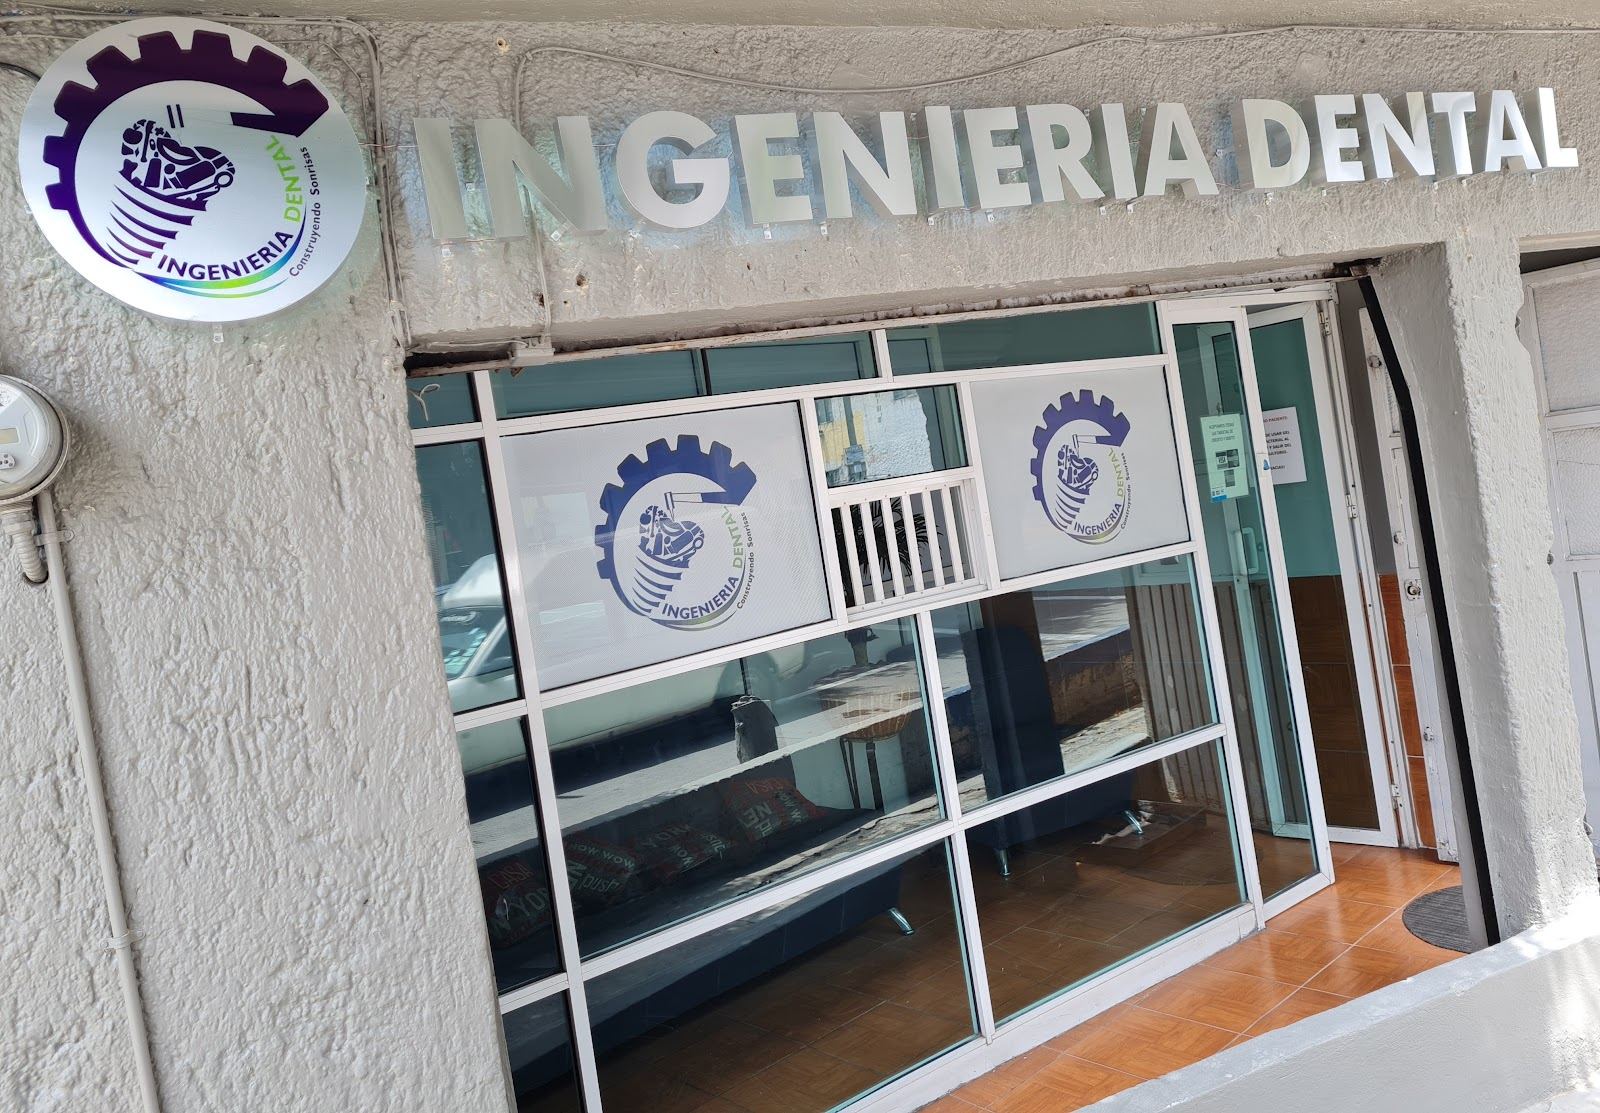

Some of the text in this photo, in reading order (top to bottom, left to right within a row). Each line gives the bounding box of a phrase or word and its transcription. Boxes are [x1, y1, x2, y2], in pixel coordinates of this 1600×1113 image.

[157, 136, 302, 280] INGENIERIA DENTAL
[289, 146, 322, 277] Construyendo Sonrisas
[413, 87, 1579, 240] INGENIERIA DENTAL
[1073, 448, 1125, 536] INGENIERIA DENTAL
[1120, 484, 1132, 529] Construyendo
[662, 506, 743, 620] INGENIERIA DENTAL
[736, 512, 756, 609] Construyendo Sonrisas
